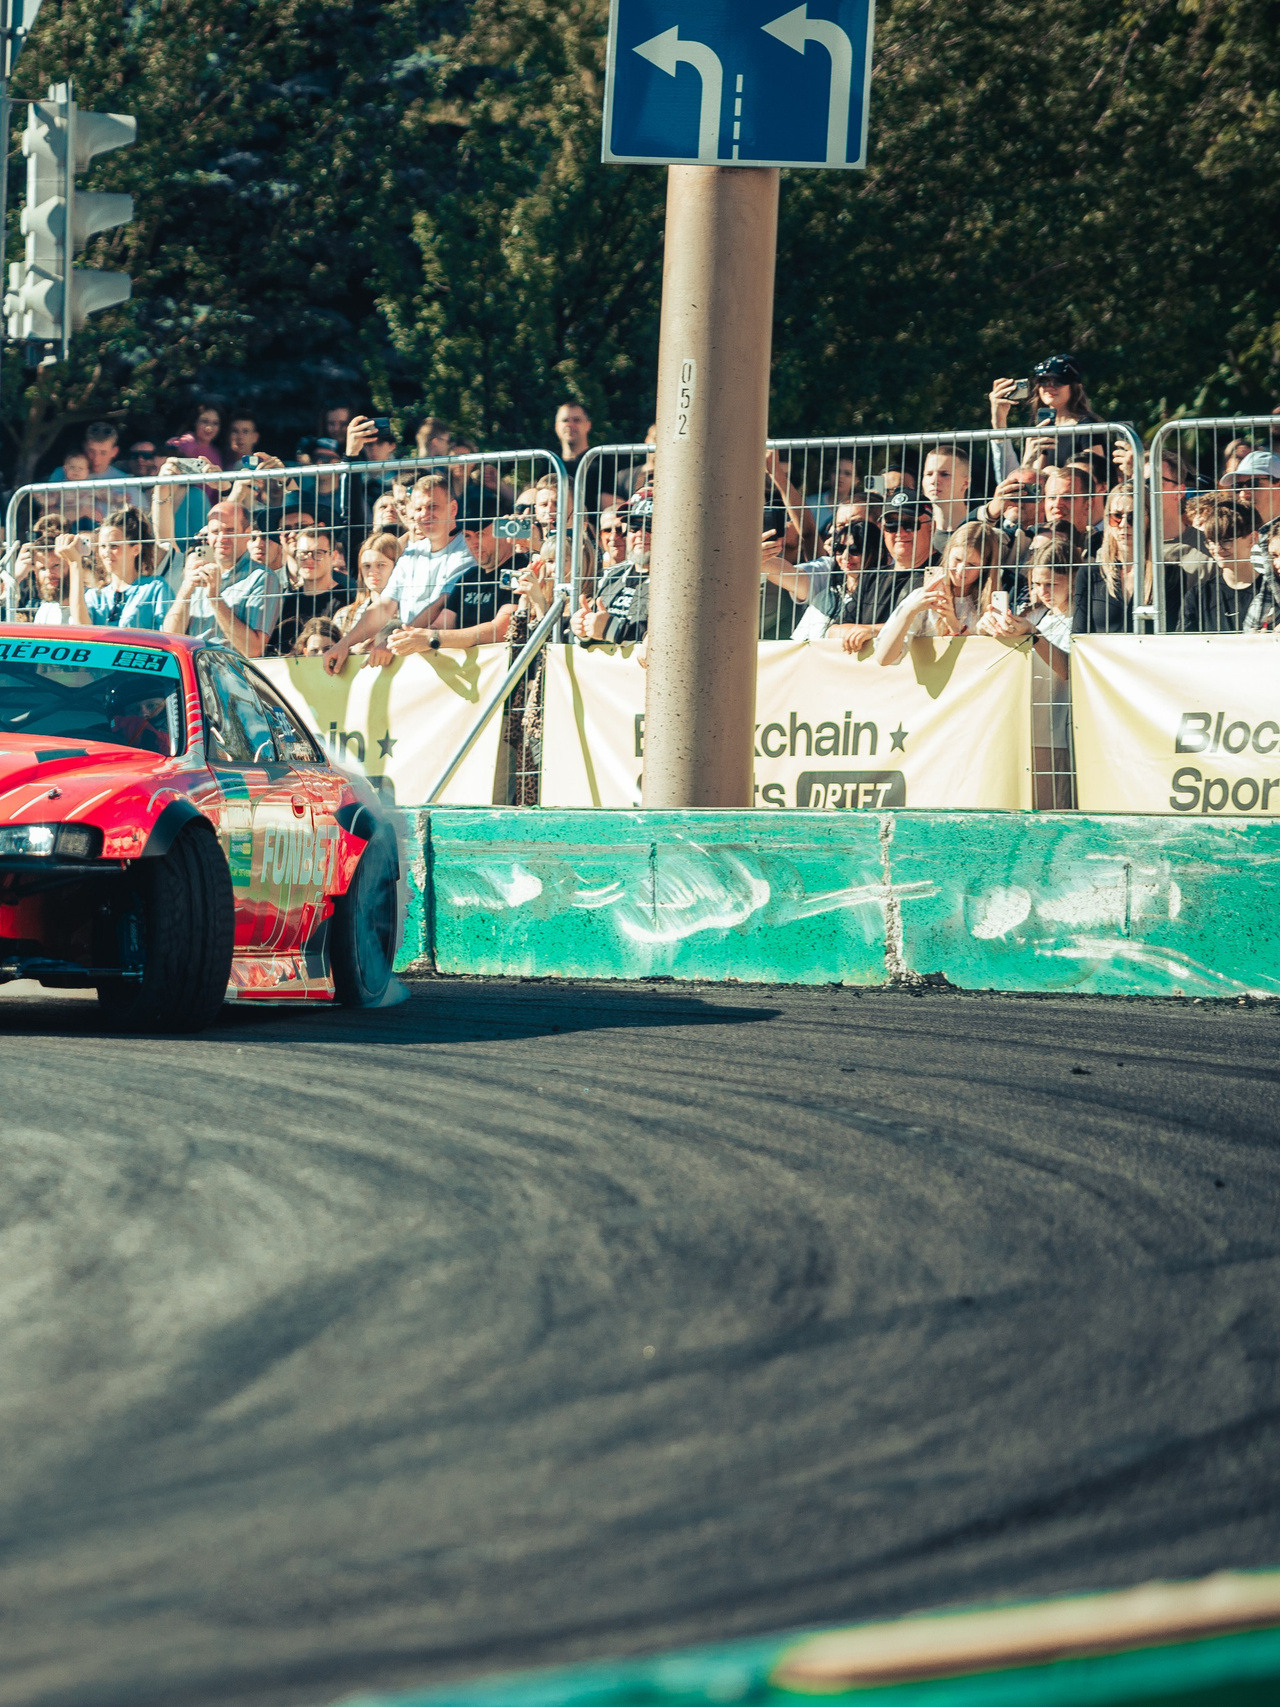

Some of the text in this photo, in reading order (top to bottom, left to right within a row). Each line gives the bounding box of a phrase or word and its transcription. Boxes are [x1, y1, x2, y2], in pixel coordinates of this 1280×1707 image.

[678, 362, 692, 435] 052
[121, 651, 163, 661] BET
[1175, 711, 1280, 754] Bloc
[260, 821, 340, 886] FONBET
